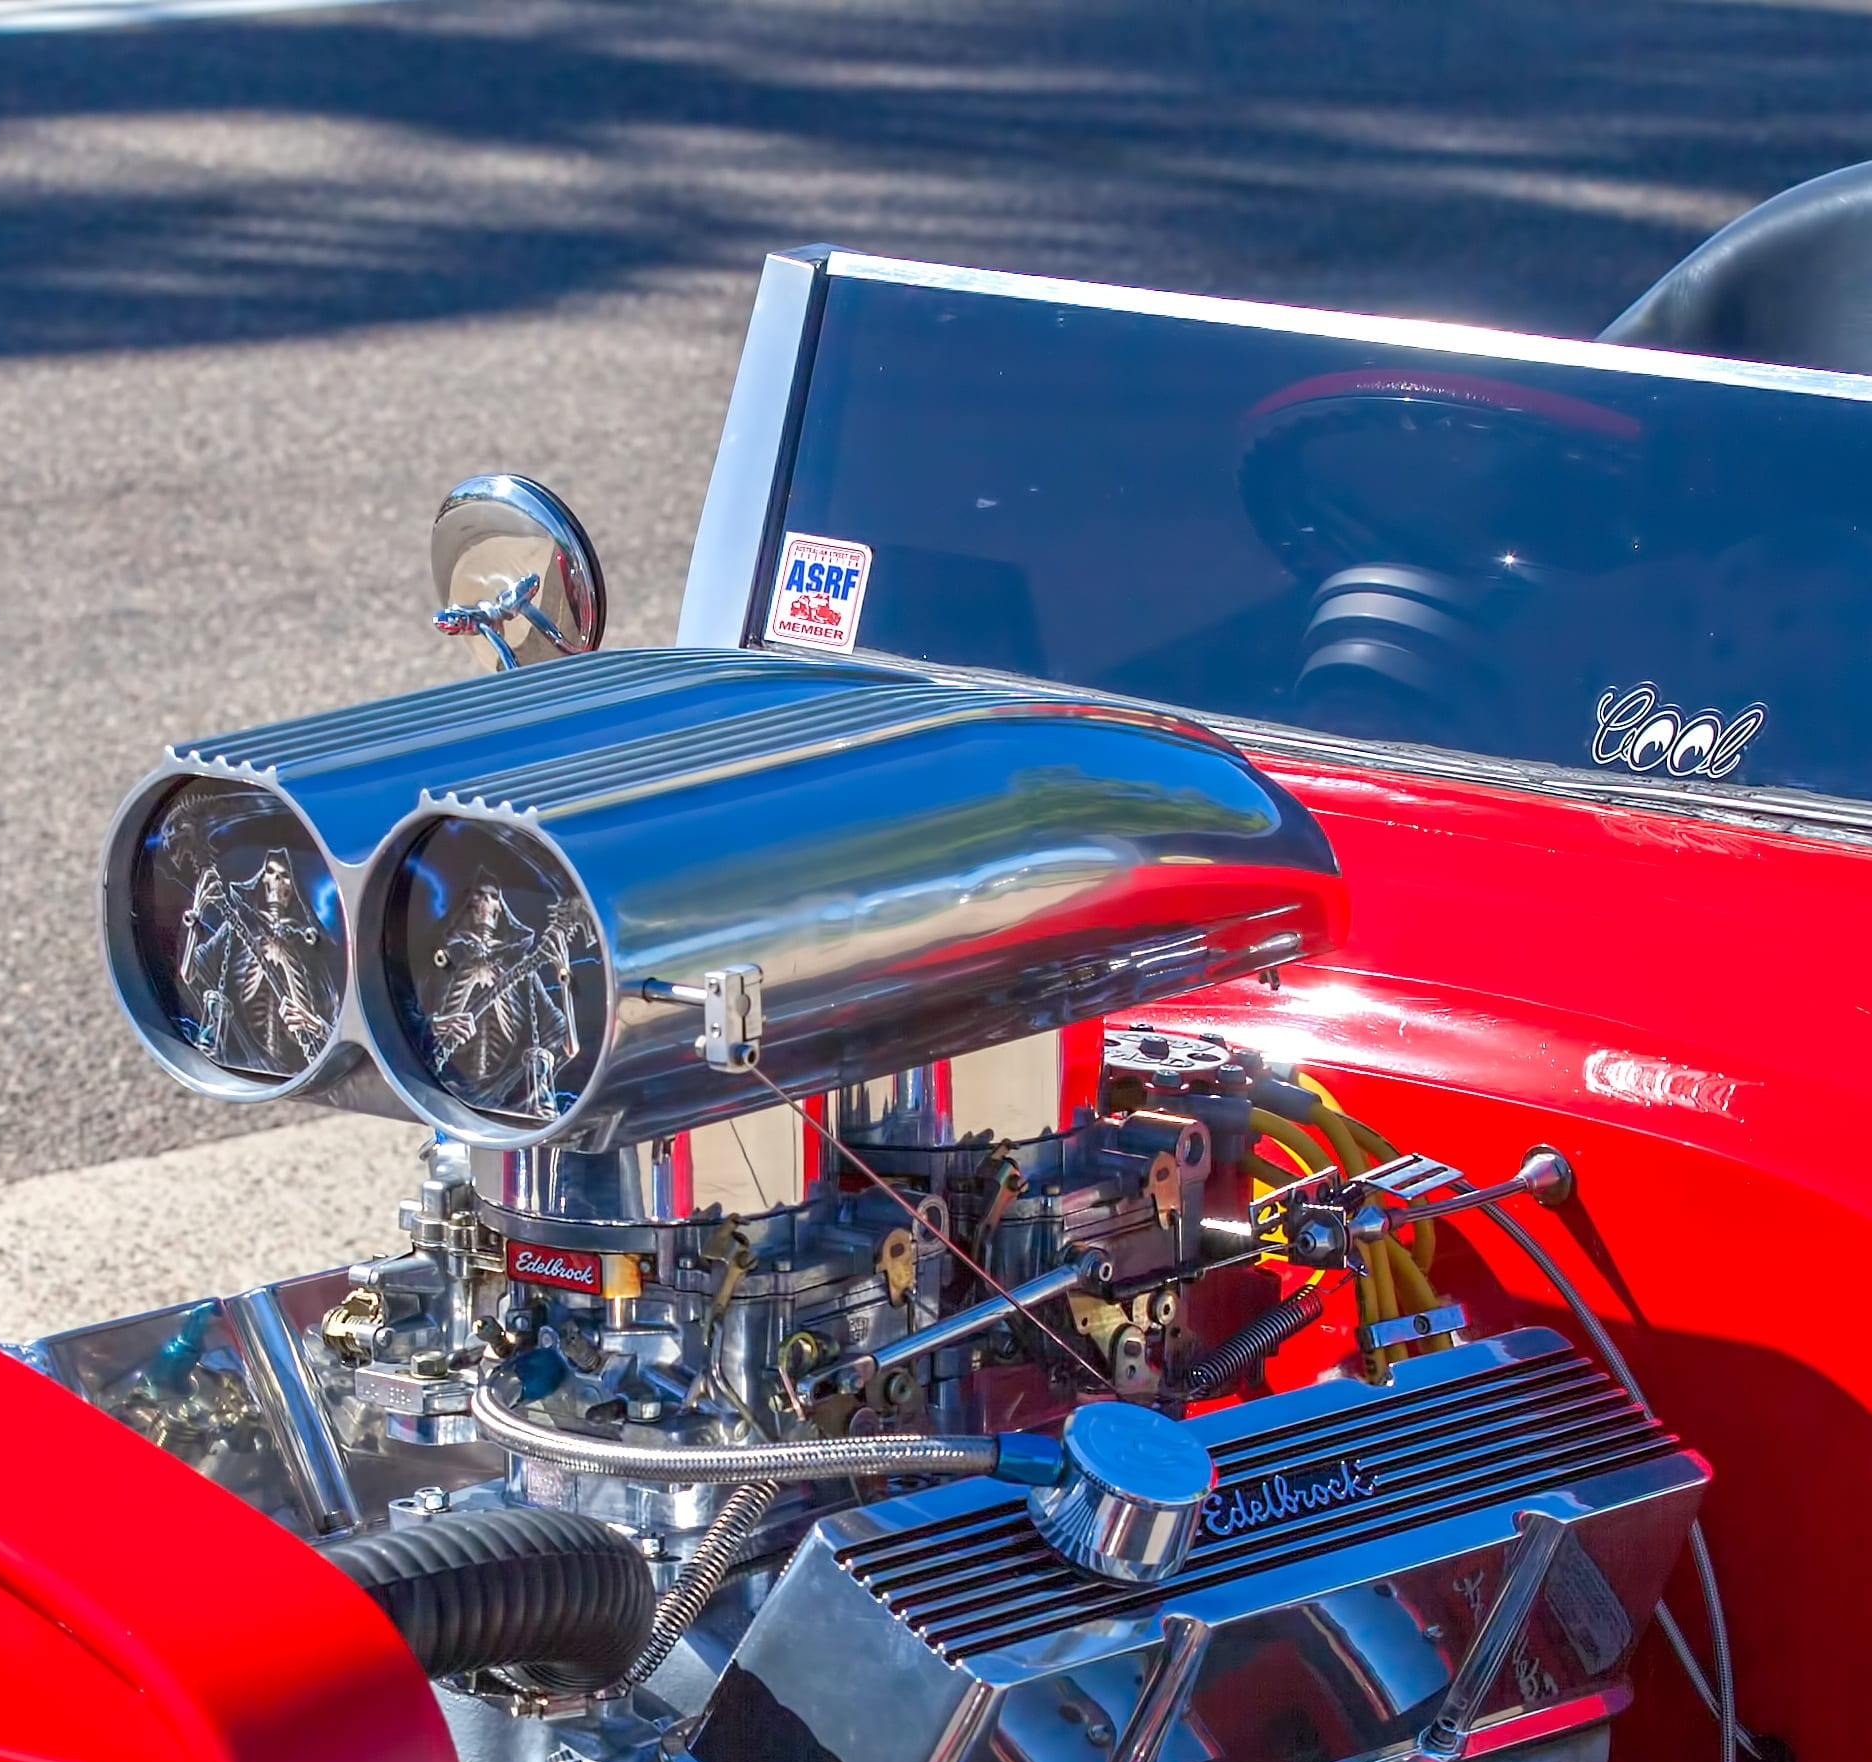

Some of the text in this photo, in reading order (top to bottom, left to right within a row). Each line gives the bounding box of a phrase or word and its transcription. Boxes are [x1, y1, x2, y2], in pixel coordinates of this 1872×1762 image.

[785, 559, 861, 600] ASRF
[779, 620, 844, 640] MEMBER
[1592, 684, 1766, 779] Cool
[514, 1251, 595, 1285] Edelbrock
[1201, 1460, 1375, 1536] Edelbrock
